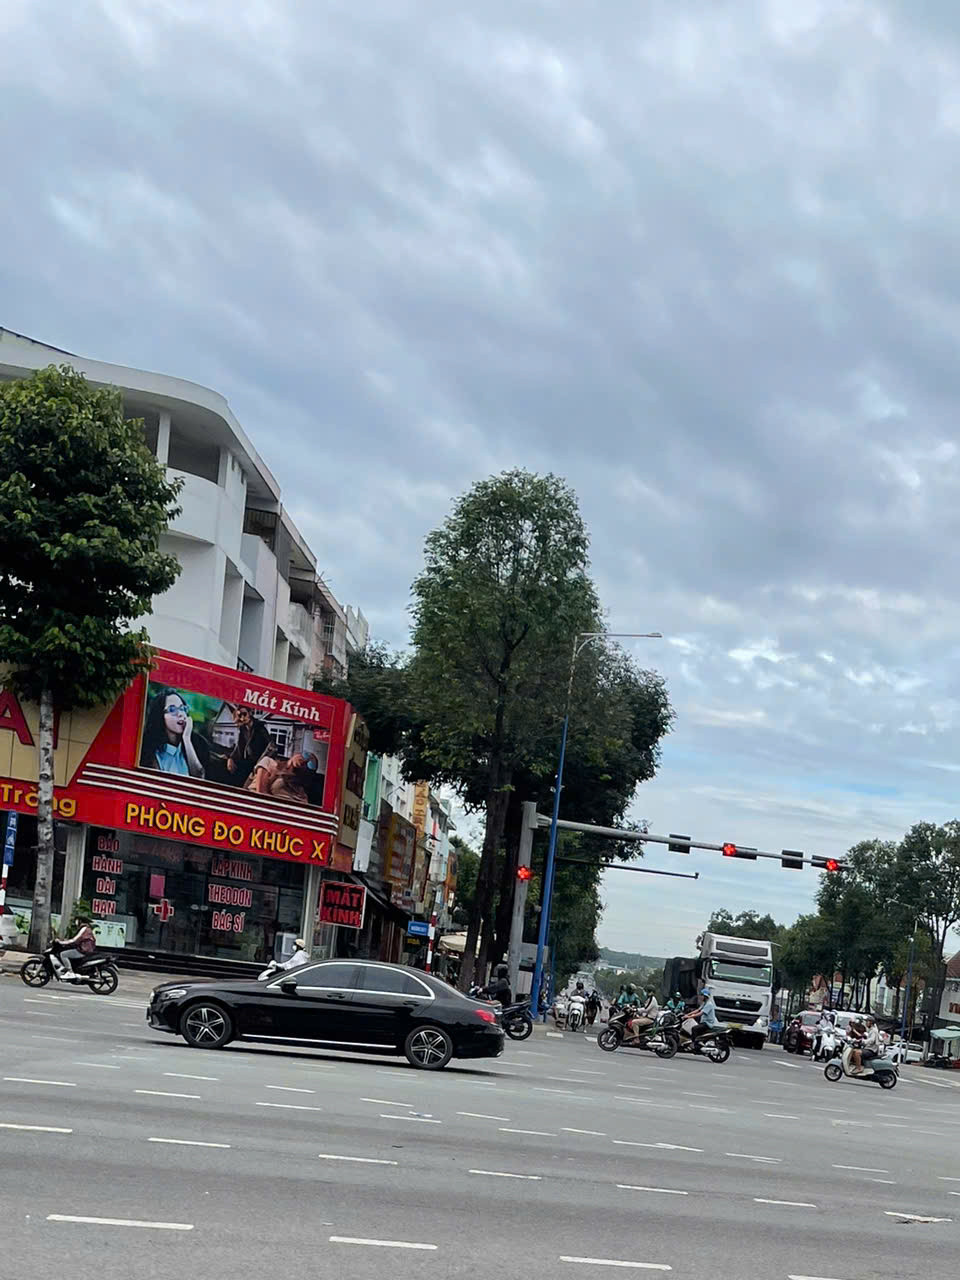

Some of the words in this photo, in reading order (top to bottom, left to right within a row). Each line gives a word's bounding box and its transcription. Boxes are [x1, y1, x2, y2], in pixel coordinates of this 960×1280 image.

[243, 689, 277, 709] Mắt
[280, 699, 320, 721] Kính
[126, 803, 205, 836] PHÒNG
[213, 821, 244, 845] ĐO
[251, 829, 304, 856] KHÚC
[311, 840, 325, 860] X
[92, 854, 123, 875] HÀNH
[92, 898, 116, 918] HẠN
